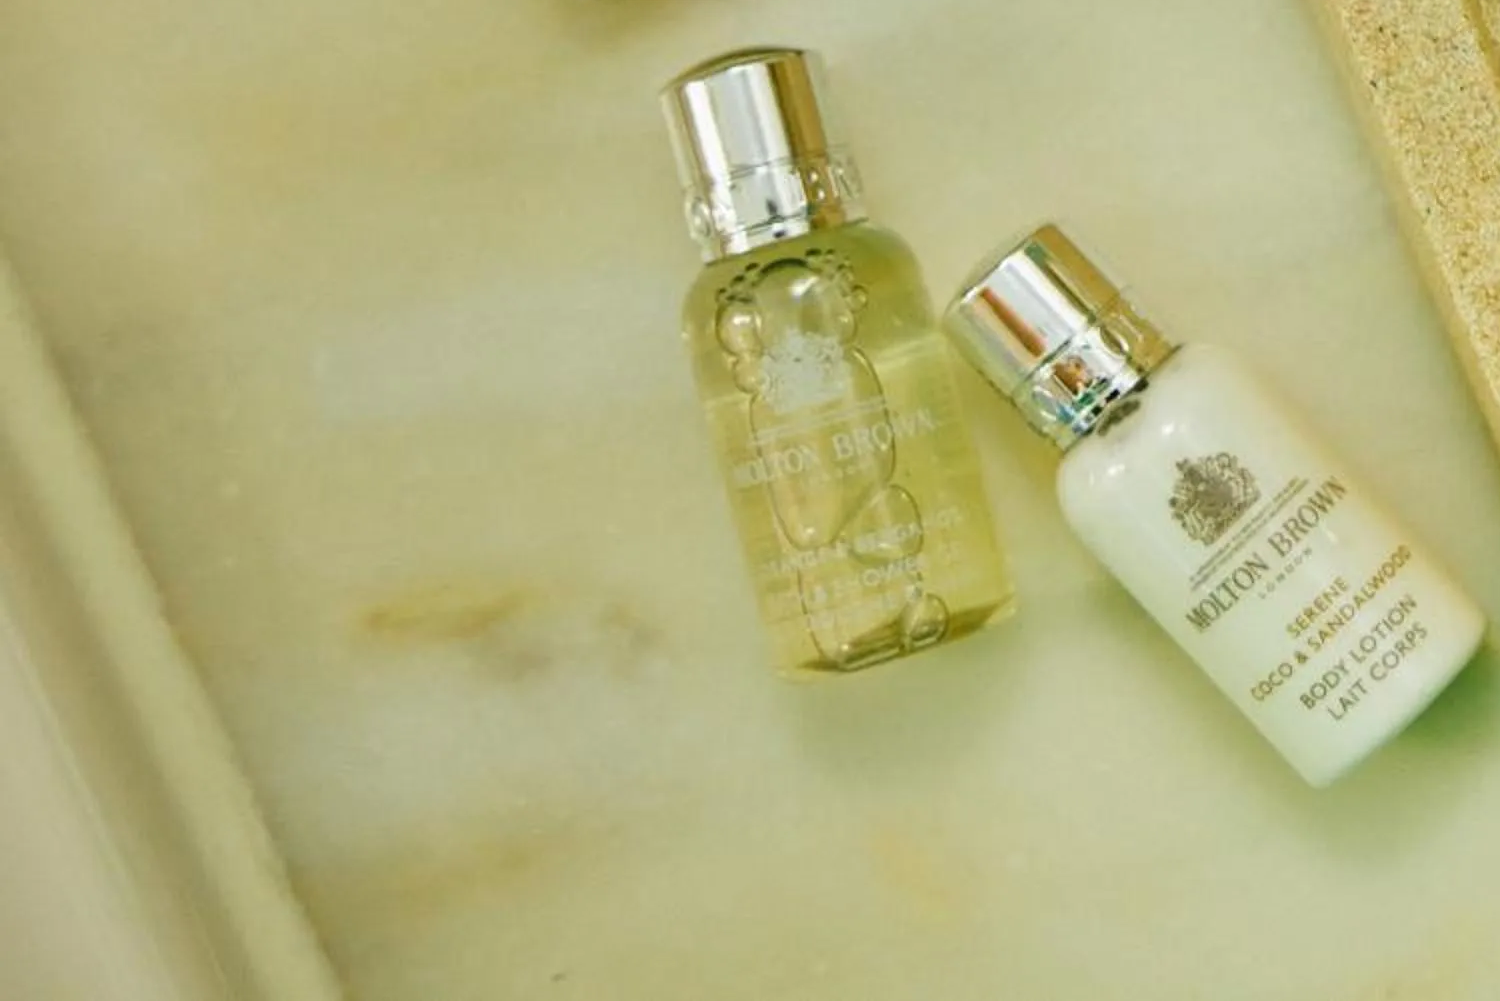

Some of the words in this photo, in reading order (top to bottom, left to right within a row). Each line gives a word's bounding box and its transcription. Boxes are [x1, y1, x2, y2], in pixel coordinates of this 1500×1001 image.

[732, 441, 820, 486] OLTON
[831, 407, 938, 461] BROWN
[1186, 552, 1269, 633] MOLTON
[1268, 475, 1347, 558] BROWN
[1286, 576, 1350, 638] SERENE
[1251, 660, 1294, 701] COCO
[1296, 650, 1310, 665] &
[1307, 545, 1412, 653] SANDALWOOD
[1300, 659, 1354, 710] BODY
[1350, 594, 1418, 665] LOTION
[1327, 680, 1368, 721] LAIT
[1370, 621, 1428, 682] CORPS
